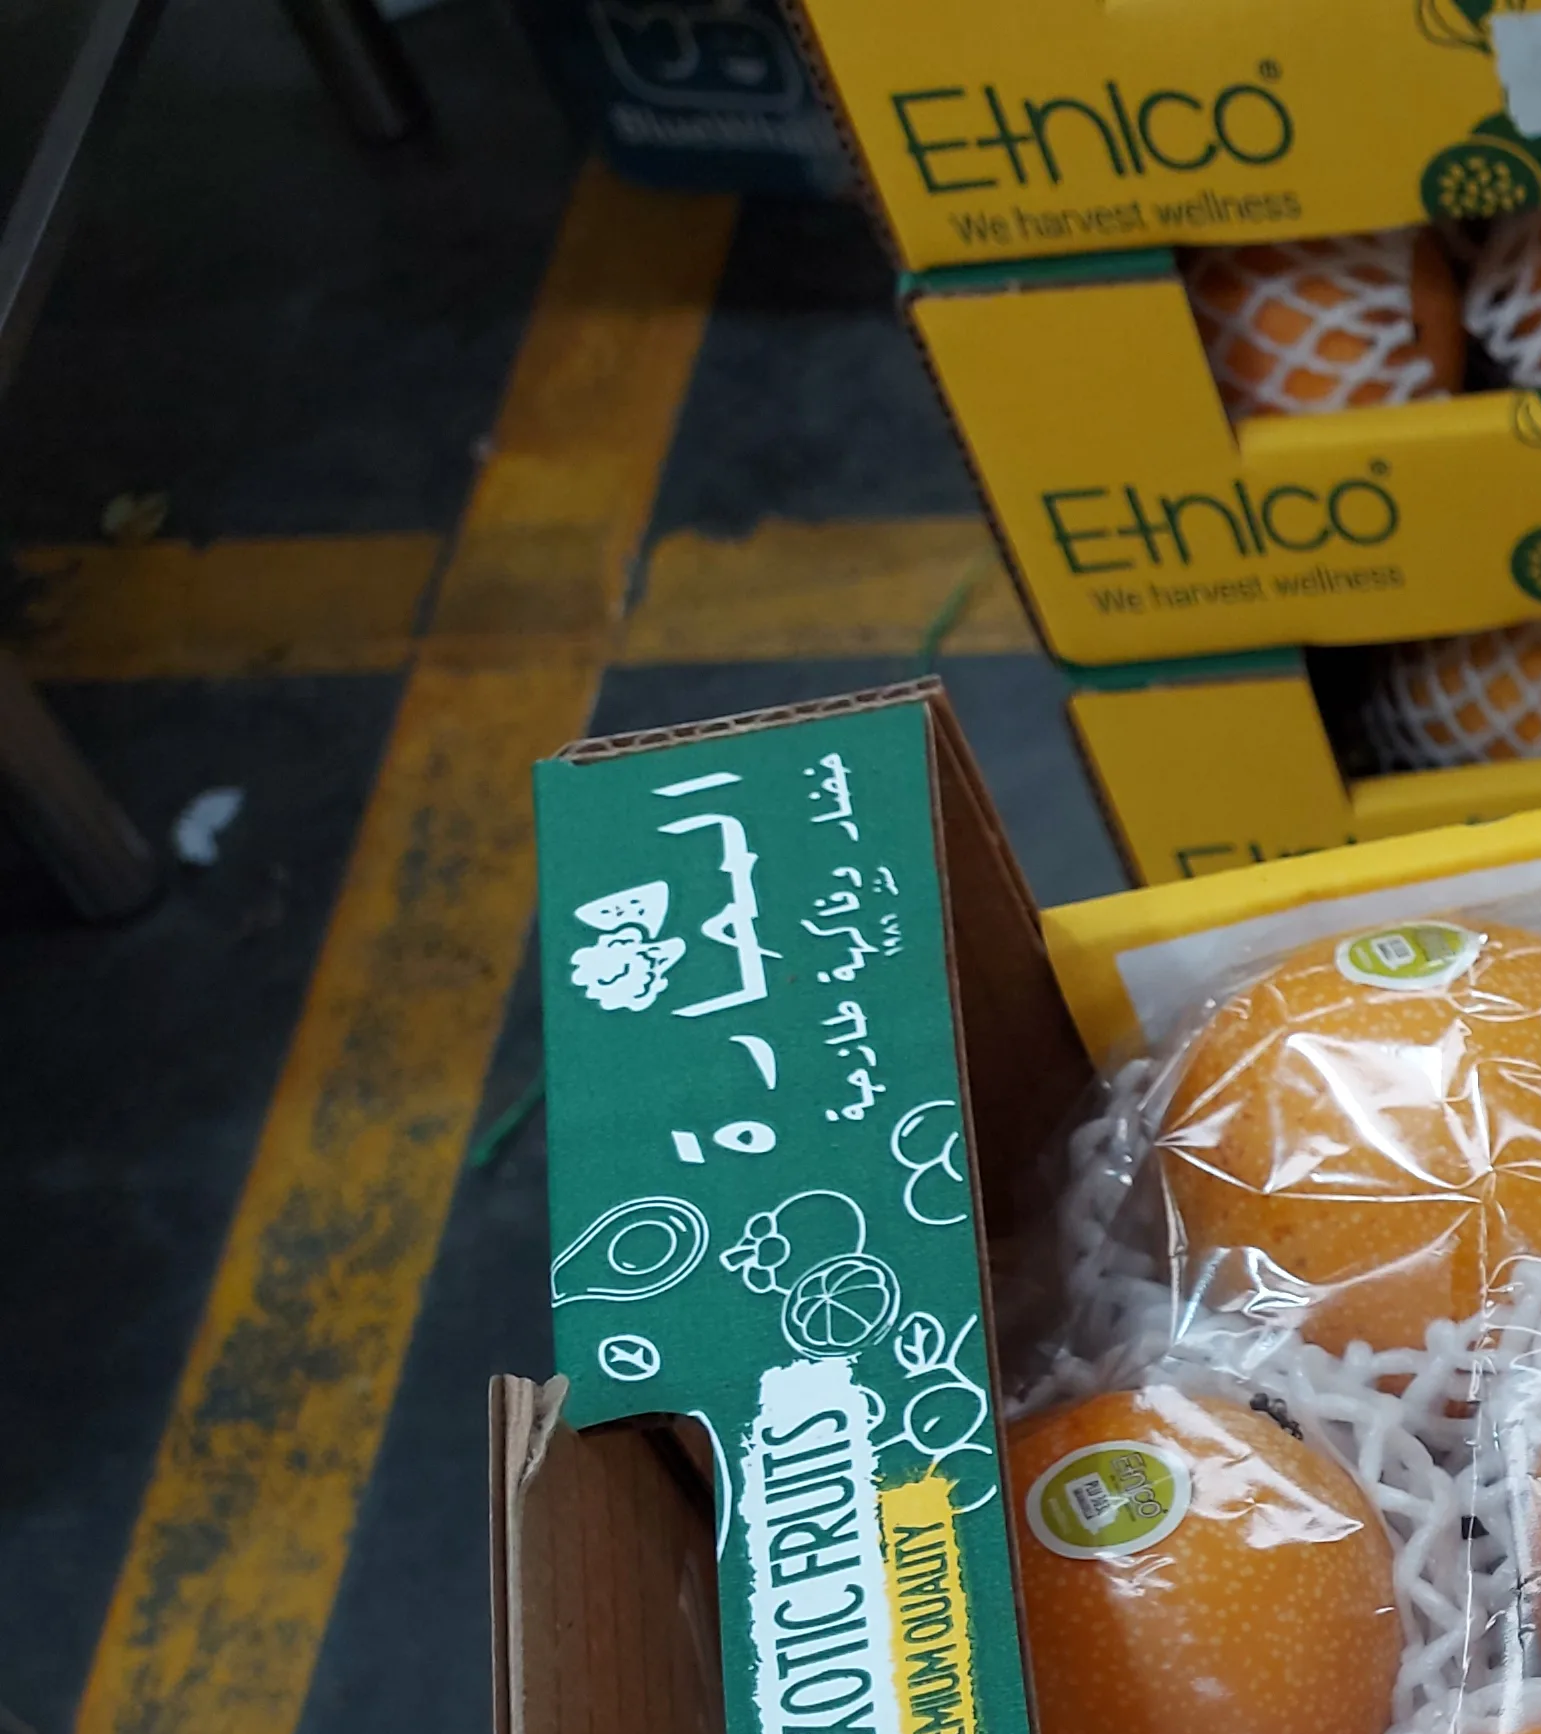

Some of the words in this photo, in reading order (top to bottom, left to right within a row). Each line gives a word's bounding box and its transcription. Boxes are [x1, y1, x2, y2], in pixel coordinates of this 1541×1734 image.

[952, 211, 1009, 247] We
[1018, 200, 1146, 241] harvest
[1155, 188, 1302, 228] wellness
[804, 752, 862, 841] خضار
[801, 866, 863, 983] وفاكهة
[822, 1000, 886, 1123] طازجة
[766, 1410, 862, 1591] FRUITS
[896, 1525, 951, 1640] QUALITY
